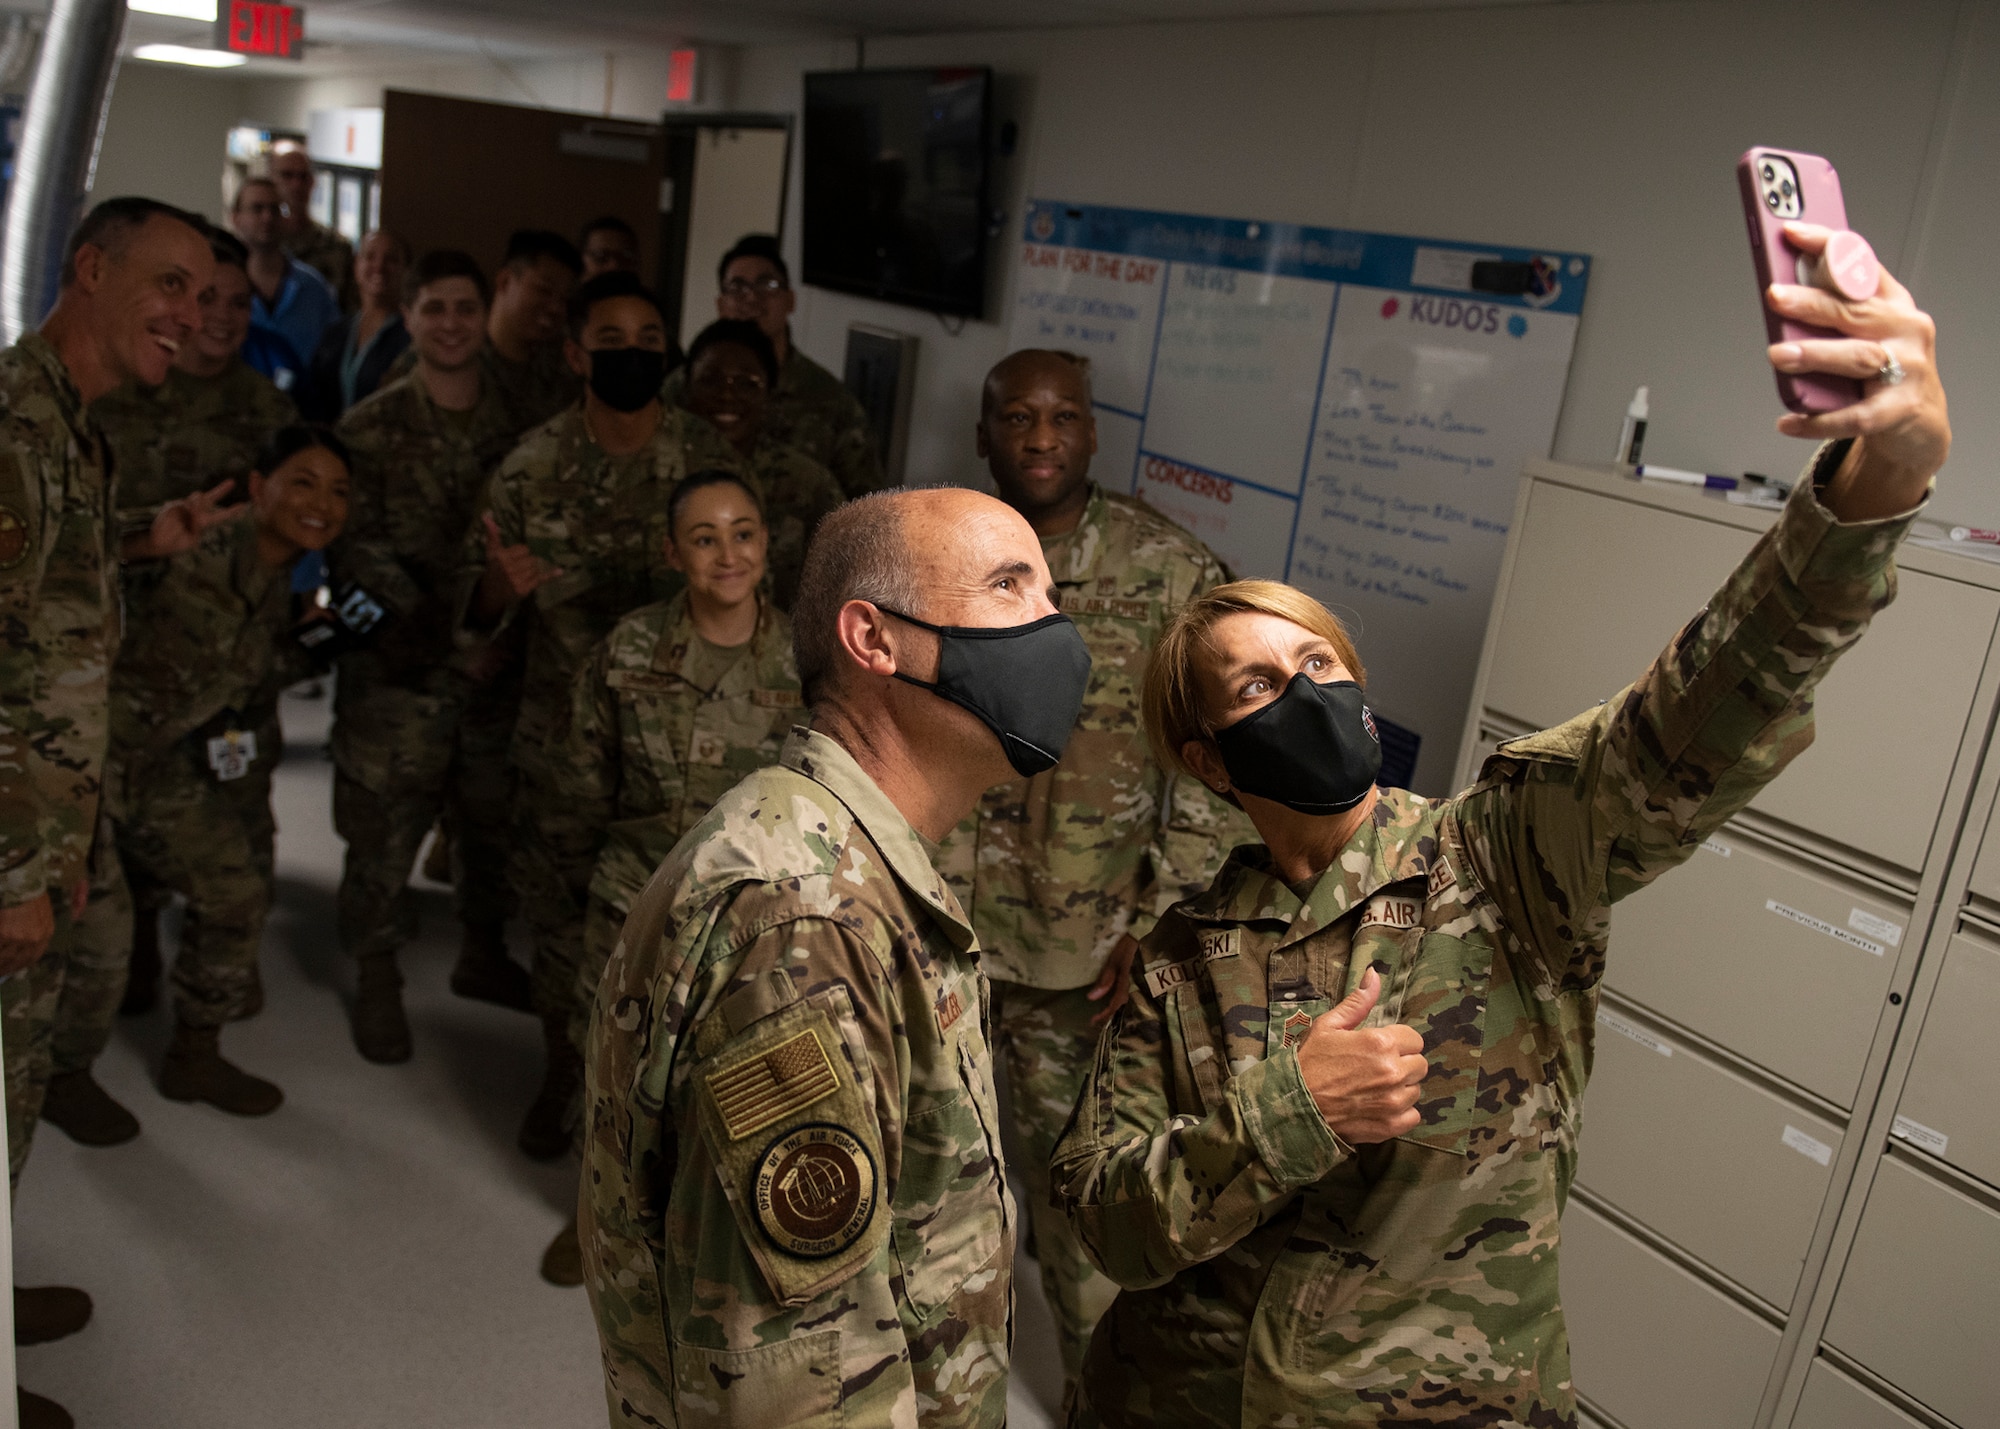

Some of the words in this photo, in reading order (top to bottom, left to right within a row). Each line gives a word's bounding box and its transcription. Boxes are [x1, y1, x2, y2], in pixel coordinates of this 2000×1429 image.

[228, 1, 293, 57] EXIT
[1024, 246, 1058, 267] PLAN
[1063, 250, 1090, 273] FOR
[1096, 255, 1121, 281] THE
[1125, 260, 1158, 285] DAY
[1185, 267, 1237, 294] NEWS
[1410, 295, 1499, 334] KUDOS
[1145, 457, 1234, 504] CONCERNS
[1085, 598, 1105, 613] AIR
[1383, 901, 1415, 925] AIR
[1774, 904, 1832, 933] PREVIOUS
[1834, 929, 1877, 953] MONTH
[757, 1173, 771, 1211] OFFICE
[769, 1152, 781, 1168] OF
[784, 1135, 803, 1152] THE
[809, 1132, 827, 1142] AIR
[833, 1134, 860, 1156] FORCE
[790, 1238, 837, 1251] SURGEON
[842, 1197, 870, 1239] GENERAL
